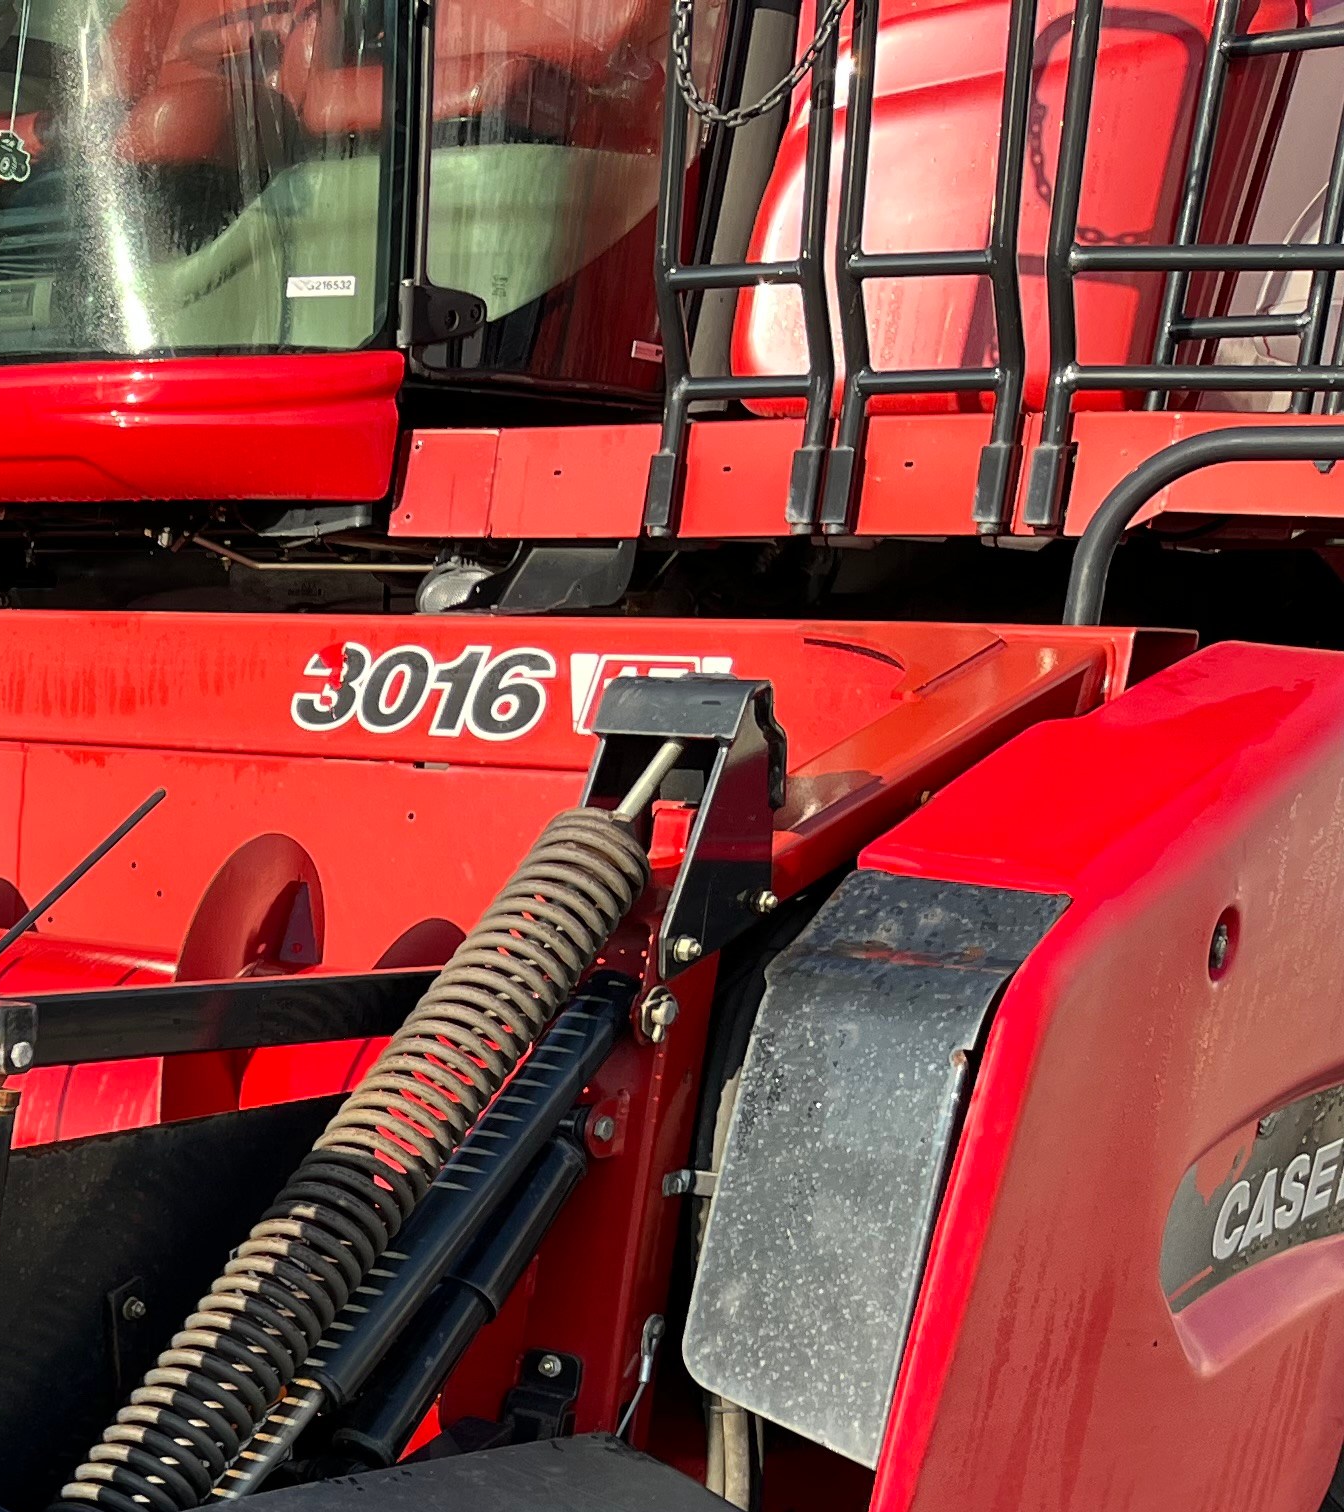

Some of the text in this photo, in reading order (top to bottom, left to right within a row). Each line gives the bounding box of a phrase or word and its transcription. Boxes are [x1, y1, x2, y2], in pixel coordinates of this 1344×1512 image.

[292, 280, 352, 291] G216532
[291, 642, 556, 741] 3016
[1211, 1138, 1344, 1260] CASE
